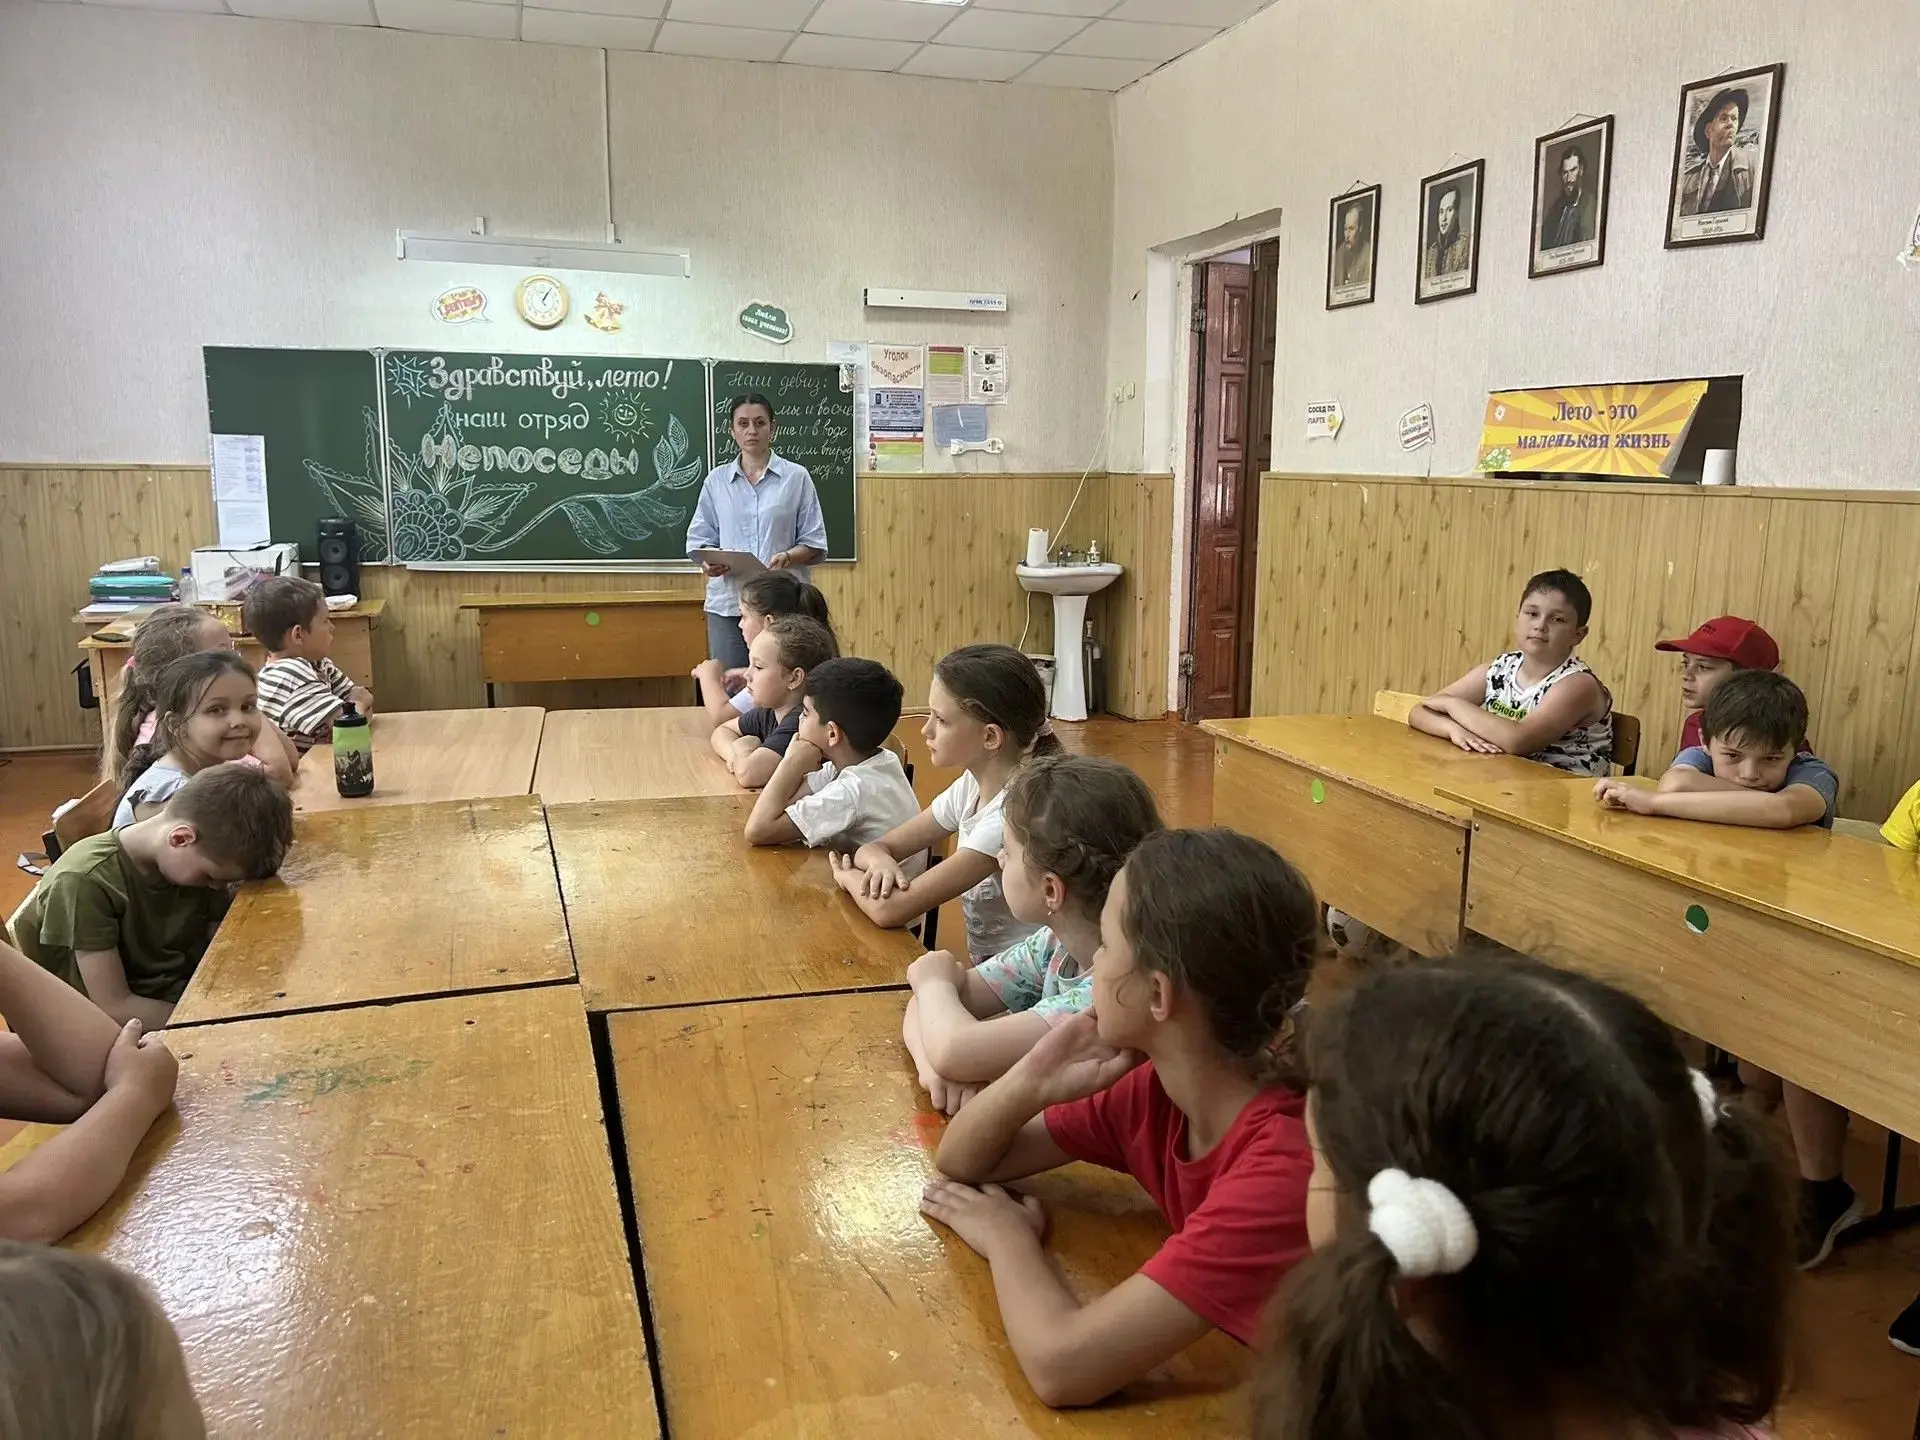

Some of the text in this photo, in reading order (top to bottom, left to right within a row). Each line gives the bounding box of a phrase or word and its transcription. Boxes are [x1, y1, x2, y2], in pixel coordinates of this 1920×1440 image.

[884, 349, 909, 361] Уголок
[428, 356, 674, 400] Здравствуй, лето!
[725, 369, 828, 397] Наш девиз:
[1308, 405, 1326, 413] СОСЕД
[1552, 401, 1592, 421] Лето
[1609, 403, 1638, 420] это
[456, 402, 590, 440] наш отряд
[1308, 416, 1326, 424] ПАРТЕ
[1518, 431, 1671, 449] маленькая жизнь
[421, 432, 640, 480] Непоседы
